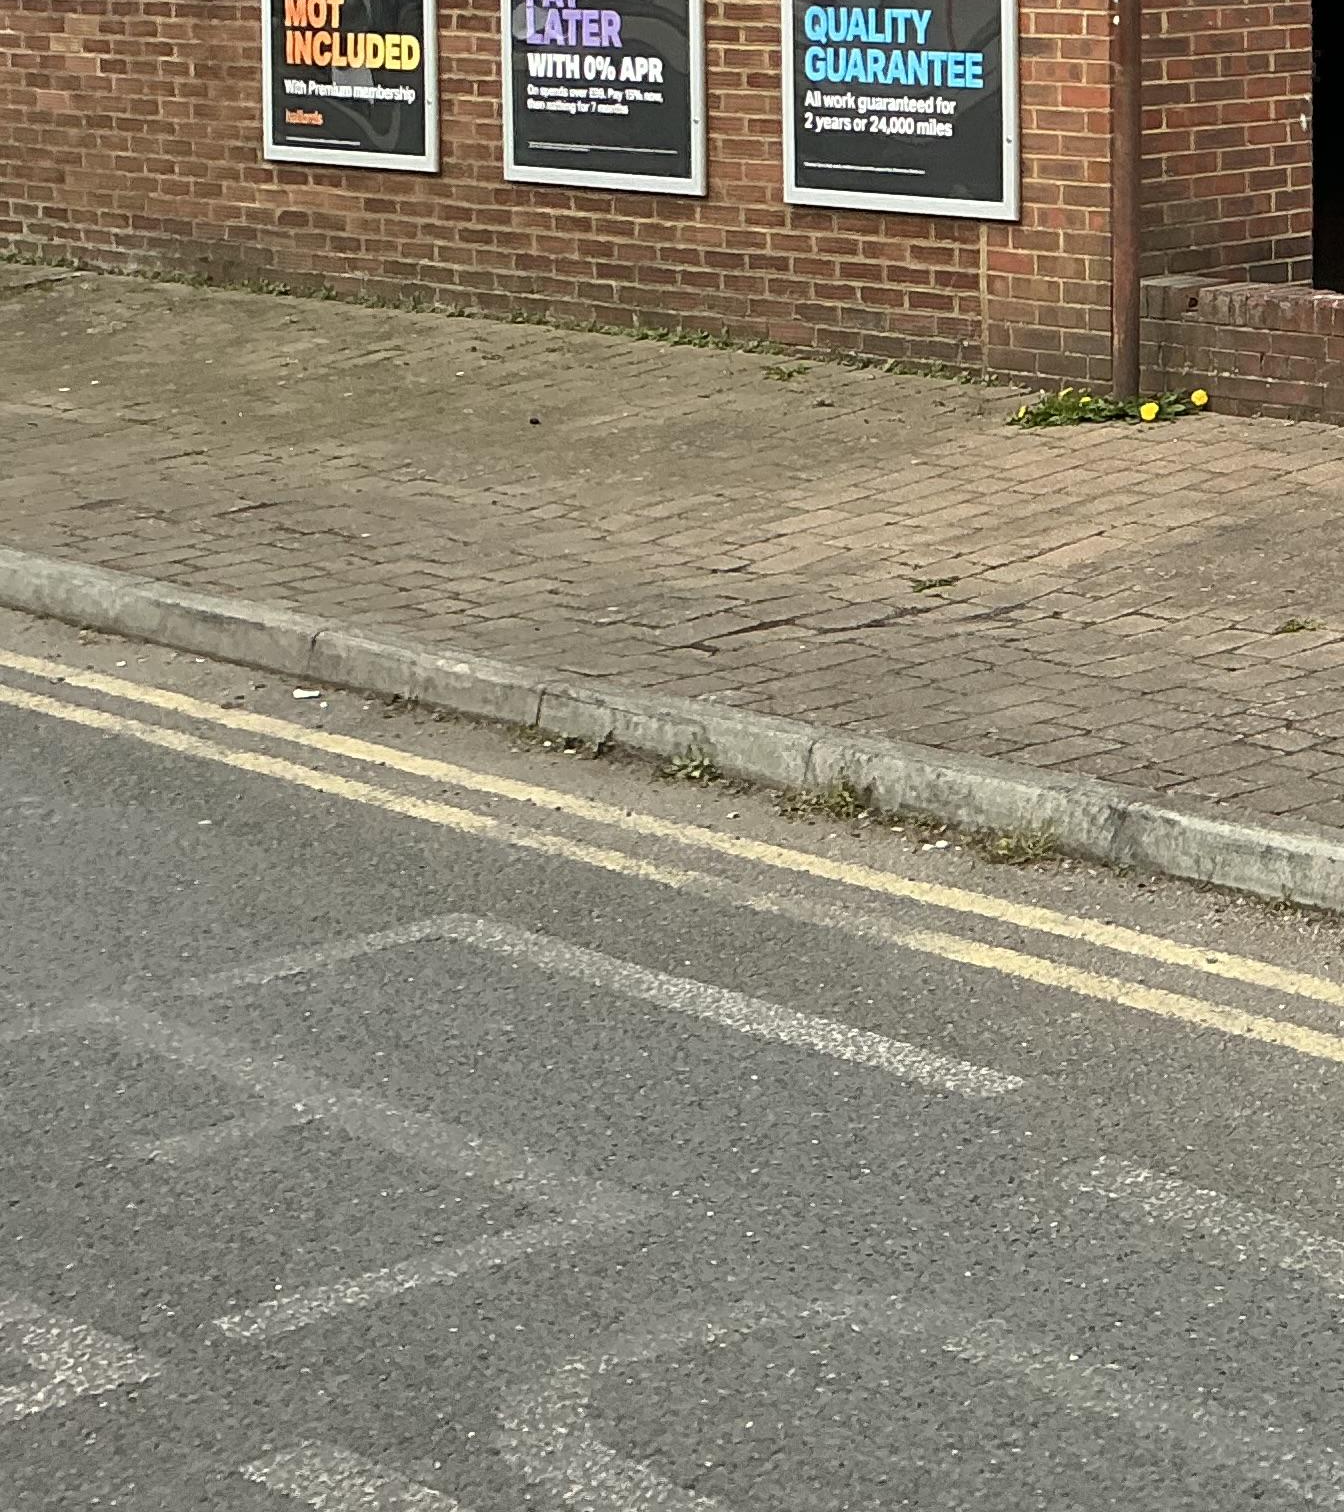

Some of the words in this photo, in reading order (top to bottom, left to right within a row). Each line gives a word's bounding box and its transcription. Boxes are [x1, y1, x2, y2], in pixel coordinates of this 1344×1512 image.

[525, 7, 623, 48] LATER
[804, 5, 932, 44] QUALITY
[286, 30, 421, 71] INCLUDED
[804, 46, 984, 88] GUARANTEE
[527, 53, 580, 79] WITH
[583, 55, 616, 81] 0%
[619, 56, 663, 83] APR
[284, 79, 307, 95] With
[308, 80, 353, 98] Premium
[353, 84, 416, 105] membership
[804, 90, 822, 107] All
[823, 92, 857, 110] work
[858, 95, 935, 115] guaranteed
[936, 96, 957, 115] for
[804, 112, 814, 129] 2
[815, 115, 852, 133] years
[853, 118, 867, 132] or
[869, 115, 914, 135] 24,000
[916, 118, 953, 137] miles
